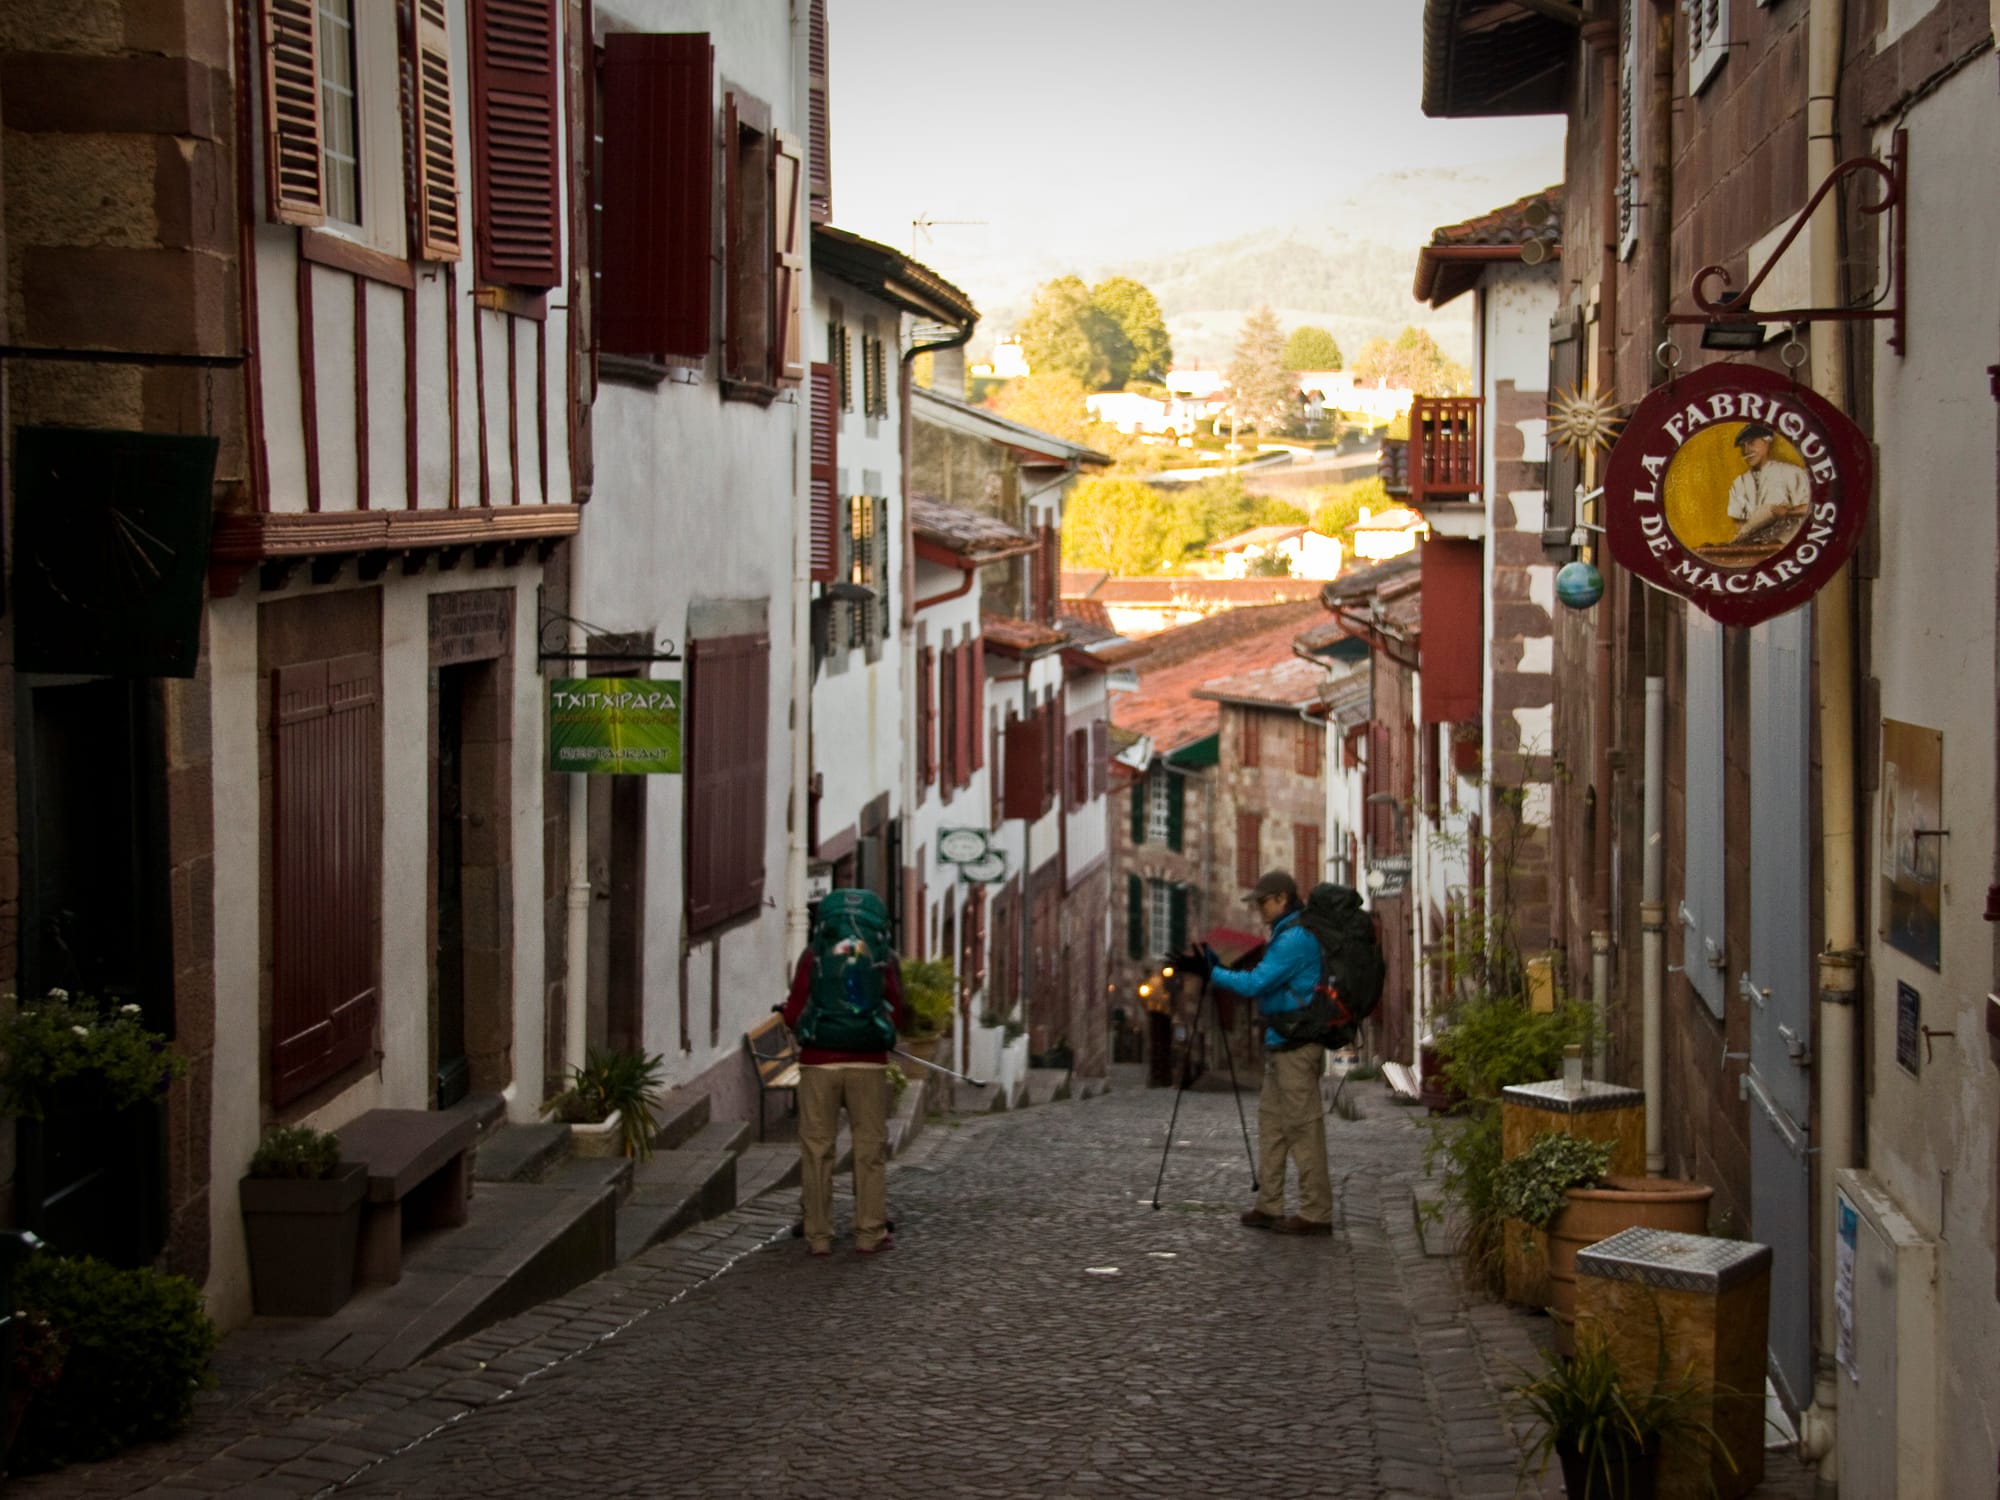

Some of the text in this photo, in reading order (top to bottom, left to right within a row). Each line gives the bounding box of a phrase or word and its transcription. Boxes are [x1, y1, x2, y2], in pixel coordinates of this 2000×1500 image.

[1633, 392, 1838, 503] LA FABRIQUE
[1640, 502, 1837, 593] DE MACARONS
[553, 691, 677, 710] TXITXIPAPA
